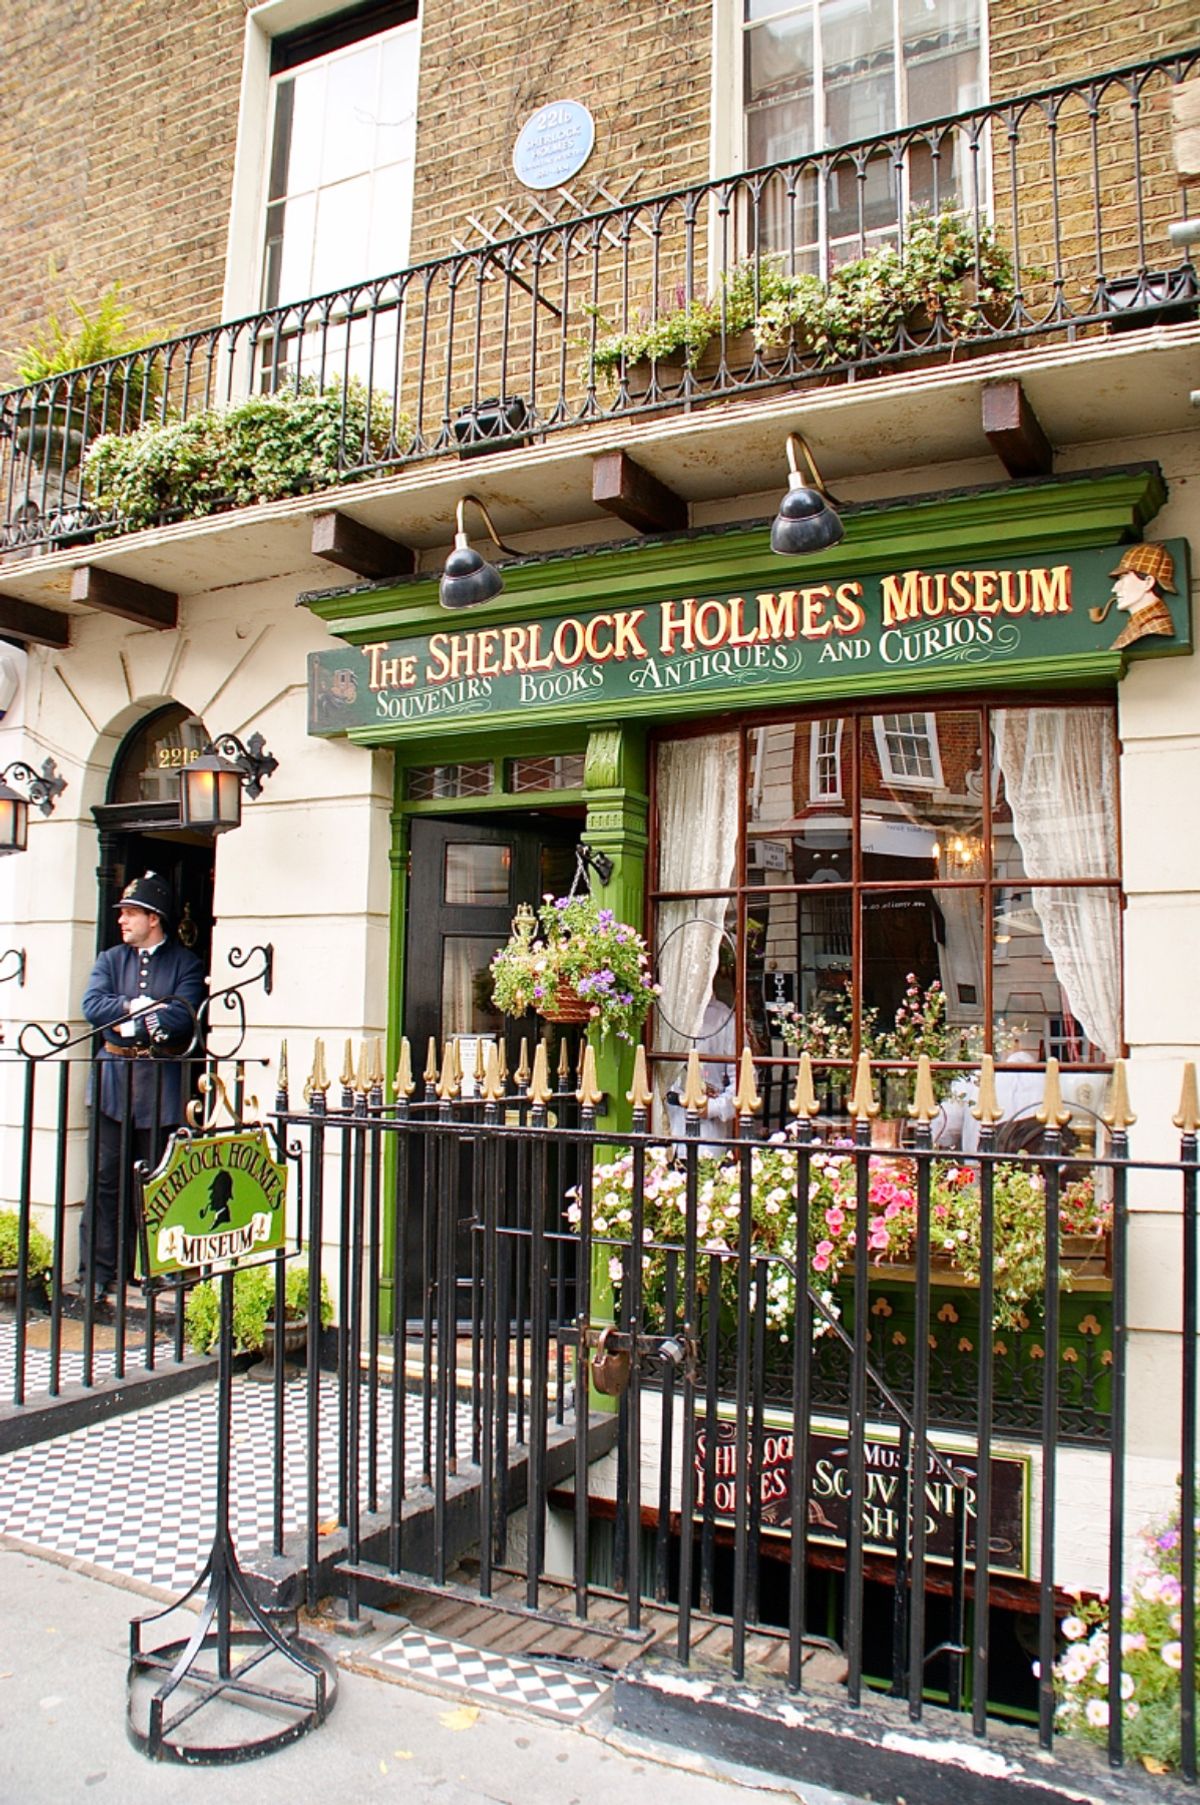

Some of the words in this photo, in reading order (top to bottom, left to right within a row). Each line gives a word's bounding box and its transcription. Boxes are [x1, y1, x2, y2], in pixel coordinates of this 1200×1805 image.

[536, 108, 572, 131] 221b
[361, 641, 417, 692] THE
[425, 609, 649, 685] SHERLOCK
[659, 581, 865, 656] HOLMES
[880, 565, 1073, 629] MUSEUM
[376, 676, 492, 719] SOUVENIRS
[519, 665, 604, 703] BOOKS
[630, 643, 789, 690] ANTIQUES
[818, 638, 872, 663] AND
[879, 616, 994, 665] CURIOS
[145, 1144, 224, 1235] SHERLOCK
[228, 1143, 285, 1211] HOLMES
[181, 1222, 255, 1264] MUSEUM
[694, 1434, 795, 1476] SHOC
[862, 1443, 954, 1475] MUU
[695, 1467, 788, 1512] OES
[812, 1459, 978, 1519] SOUVNIR
[861, 1500, 938, 1541] SHP
